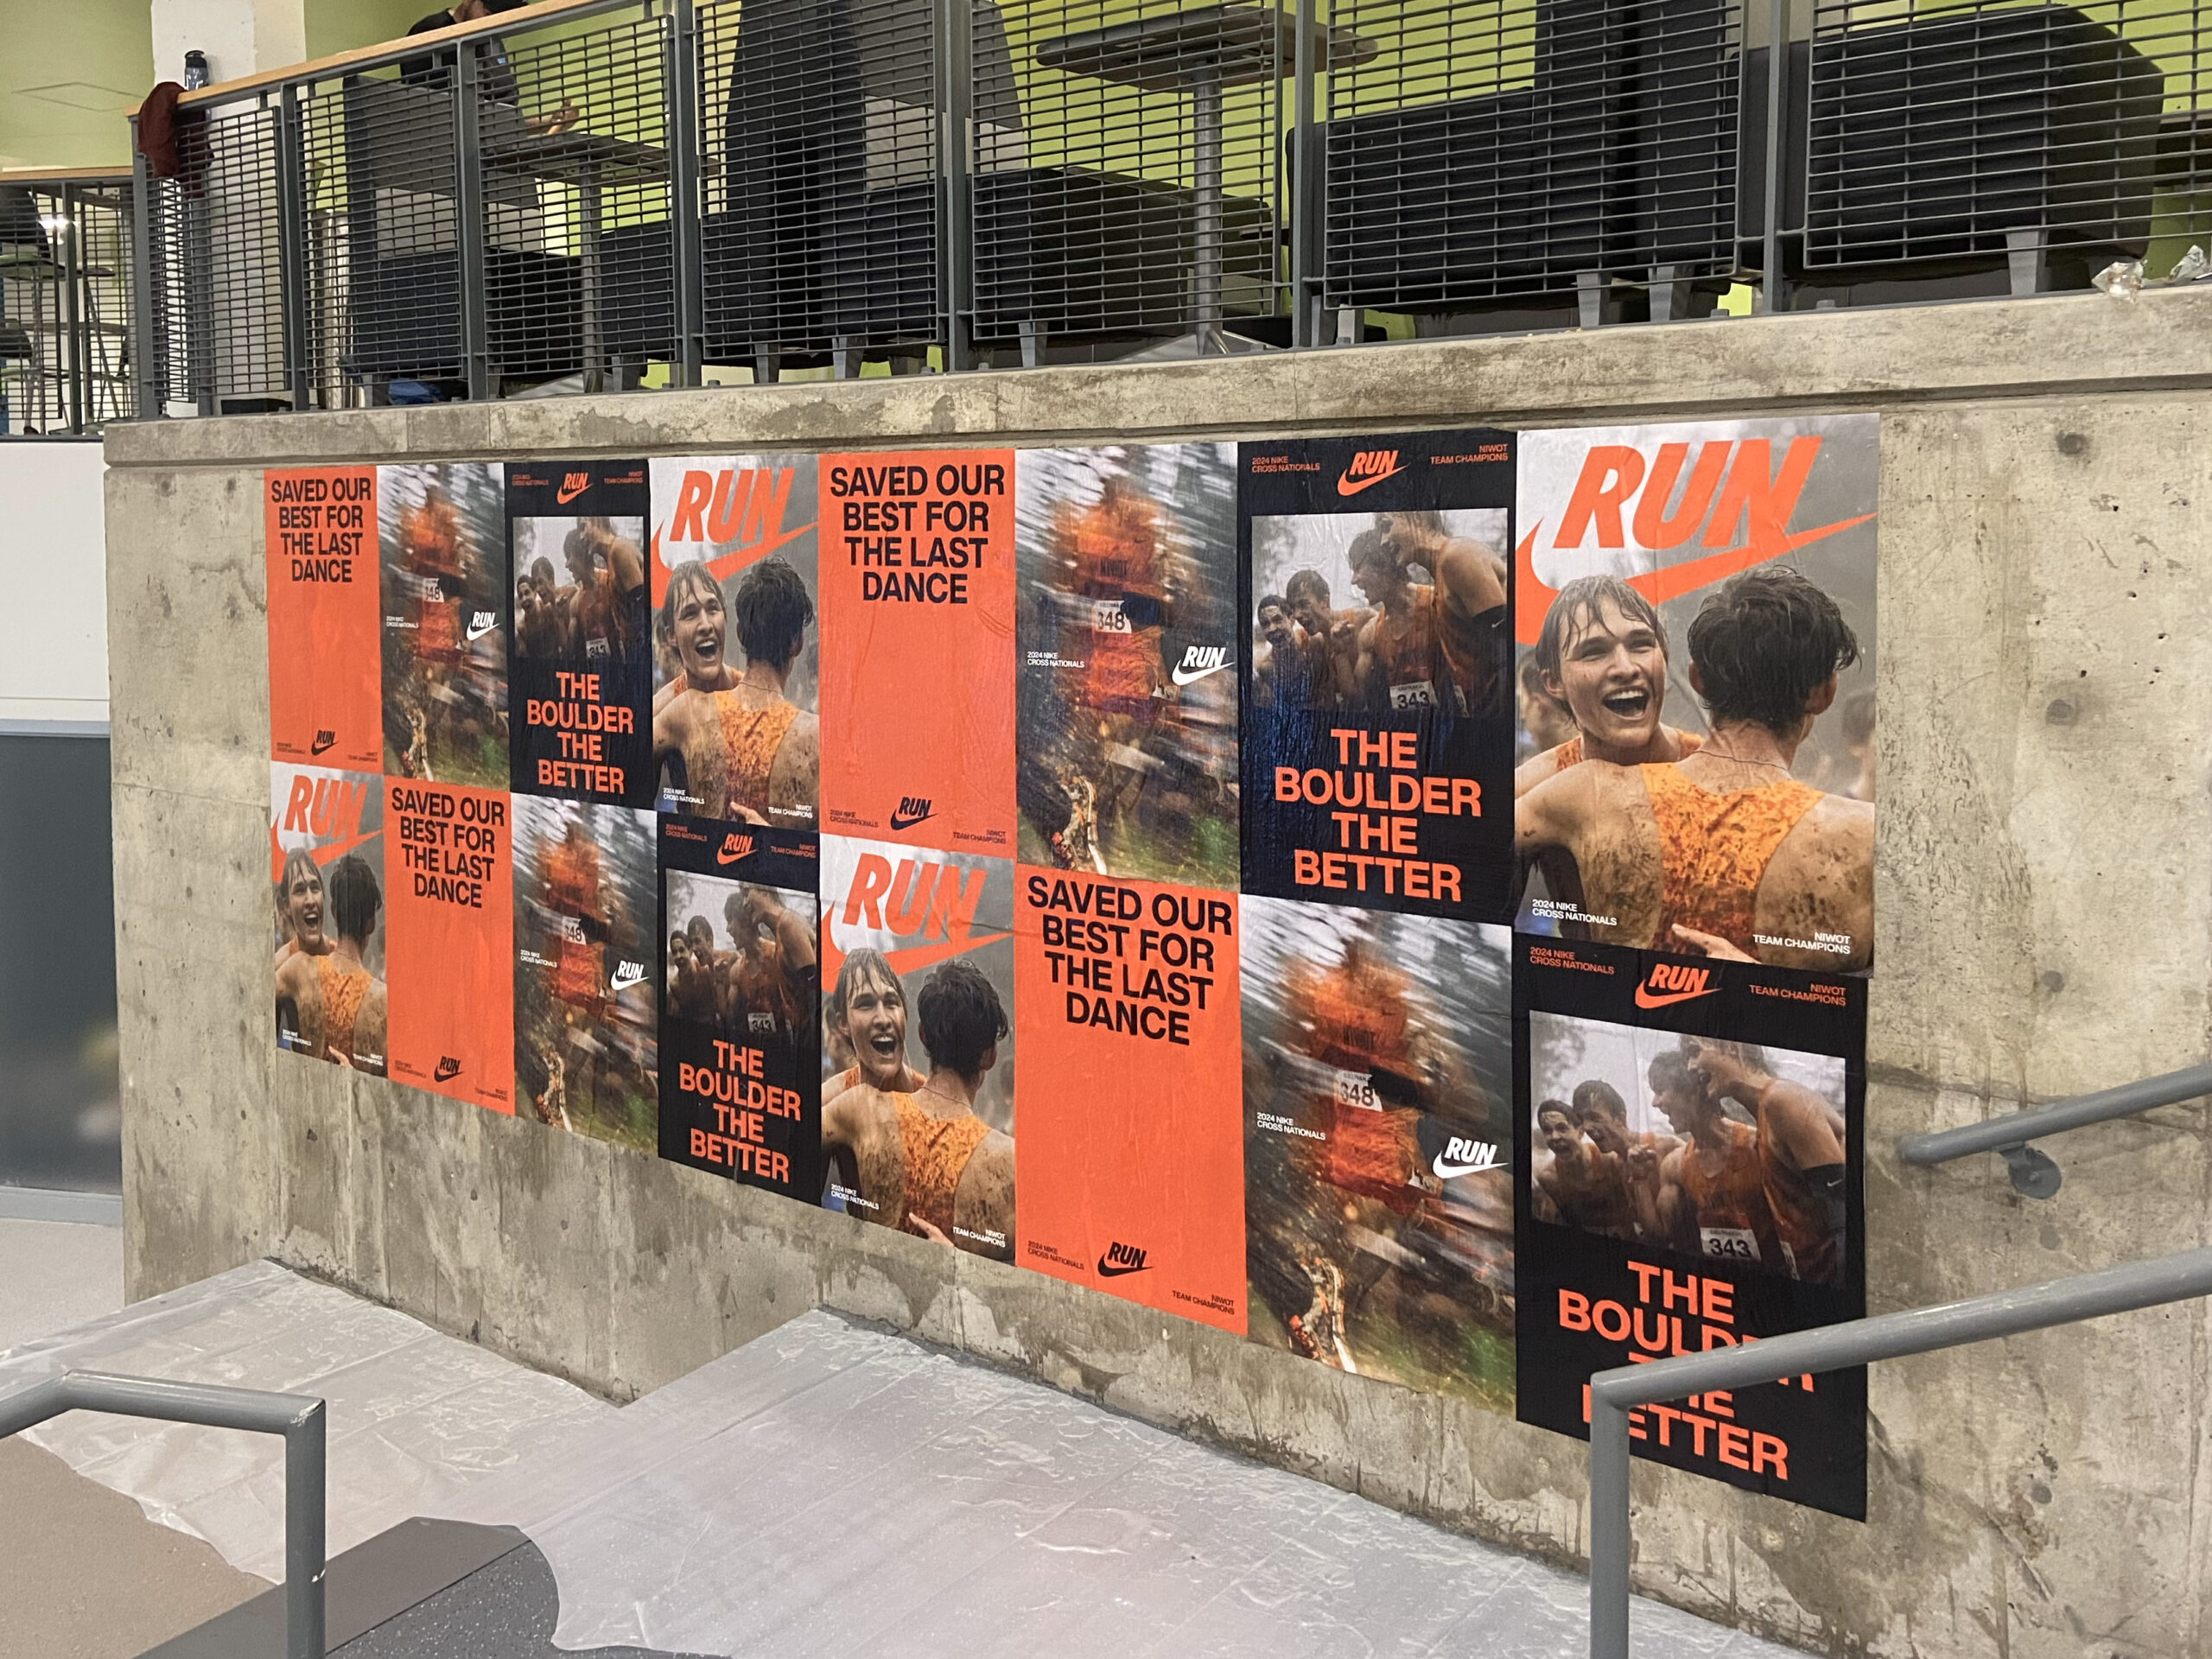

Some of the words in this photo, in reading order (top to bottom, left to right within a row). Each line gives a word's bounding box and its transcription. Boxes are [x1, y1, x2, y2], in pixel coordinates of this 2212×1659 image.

[1430, 455, 1453, 465] TEAM
[1455, 453, 1508, 463] CHAMPIONS
[1479, 443, 1508, 453] NIWOT
[1252, 464, 1277, 473] CROSS
[1278, 462, 1320, 472] NATIONALS
[1350, 449, 1399, 475] RUN
[271, 478, 328, 503] SAVED
[332, 477, 372, 501] OUR
[563, 473, 588, 489] RUN
[830, 466, 928, 497] SAVED
[936, 464, 1005, 496] OUR
[1553, 435, 1822, 550] RUN
[279, 505, 320, 529] BEST
[327, 505, 363, 529] FOR
[669, 467, 795, 543] RUN
[843, 501, 918, 531] BEST
[926, 501, 989, 532] FOR
[281, 533, 314, 556] THE
[318, 532, 363, 556] LAST
[844, 537, 901, 566] THE
[911, 537, 988, 568] LAST
[292, 559, 353, 582] DANCE
[863, 571, 968, 604] DANCE
[473, 612, 495, 627] RUN
[1098, 611, 1125, 631] 348
[1050, 659, 1085, 668] NATIONALS
[1182, 645, 1226, 668] RUN
[556, 671, 600, 700] THE
[1397, 691, 1430, 709] 343
[527, 699, 633, 734] BOULDER
[316, 729, 335, 743] RUN
[557, 732, 602, 761] THE
[1331, 728, 1417, 769] THE
[538, 760, 625, 794] BETTER
[679, 796, 705, 804] NATIONALS
[1274, 766, 1482, 817] BOULDER
[284, 774, 367, 838] RUN
[391, 787, 454, 818] SAVED
[461, 798, 505, 826] OUR
[783, 809, 813, 819] CHAMPIONS
[899, 797, 931, 817] RUN
[401, 816, 448, 845] BEST
[454, 825, 495, 854] FOR
[724, 833, 753, 852] RUN
[953, 831, 969, 840] TEAM
[970, 834, 1006, 844] CHAMPIONS
[1331, 811, 1418, 855] THE
[402, 843, 439, 873] THE
[445, 853, 494, 882] LAST
[1294, 849, 1462, 902] BETTER
[415, 873, 482, 908] DANCE
[842, 852, 988, 941] RUN
[1027, 876, 1142, 921] SAVED
[1152, 893, 1232, 936] OUR
[1532, 899, 1554, 909] 2024
[1555, 902, 1577, 912] NIKE
[1532, 908, 1563, 919] CROSS
[1566, 911, 1618, 925] NATIONALS
[1043, 914, 1129, 957] BEST
[1140, 929, 1214, 973] FOR
[1752, 934, 1782, 946] TEAM
[1784, 938, 1851, 954] CHAMPIONS
[1815, 931, 1851, 944] NIWOT
[1530, 947, 1552, 957] 2024
[1554, 950, 1575, 961] NIKE
[1530, 956, 1561, 967] CROSS
[1563, 959, 1615, 975] NATIONALS
[618, 960, 644, 980] RUN
[1045, 950, 1113, 994] THE
[1123, 963, 1213, 1010] LAST
[1649, 963, 1710, 992] RUN
[1749, 984, 1778, 997] TEAM
[1781, 988, 1847, 1007] CHAMPIONS
[1810, 982, 1847, 995] NIWOT
[1066, 991, 1190, 1046] DANCE
[439, 1055, 461, 1073] RUN
[713, 1039, 764, 1078] THE
[679, 1062, 801, 1122] BOULDER
[1340, 1082, 1374, 1106] 348
[713, 1103, 764, 1144] THE
[1257, 1112, 1274, 1122] 2024
[1276, 1116, 1294, 1126] NIKE
[1257, 1121, 1282, 1133] CROSS
[1284, 1126, 1325, 1141] NATIONALS
[690, 1128, 789, 1183] BETTER
[1444, 1136, 1497, 1165] RUN
[831, 1184, 844, 1192] 2024
[844, 1187, 857, 1196] NIKE
[831, 1191, 849, 1202] CROSS
[850, 1196, 879, 1210] NATIONALS
[953, 1227, 969, 1236] TEAM
[969, 1230, 1006, 1248] CHAMPIONS
[986, 1230, 1006, 1240] NIWOT
[1028, 1241, 1043, 1251] 2024
[1044, 1245, 1058, 1255] NIKE
[1028, 1248, 1049, 1260] CROSS
[1050, 1254, 1084, 1270] NATIONALS
[1107, 1242, 1147, 1268] RUN
[1709, 1238, 1751, 1258] 343
[1173, 1290, 1192, 1302] TEAM
[1192, 1297, 1235, 1315] CHAMPIONS
[1211, 1294, 1234, 1306] NIWOT
[1627, 1260, 1734, 1325] THE
[1559, 1288, 1815, 1392] BOULD
[1582, 1383, 1789, 1480] ETTER
